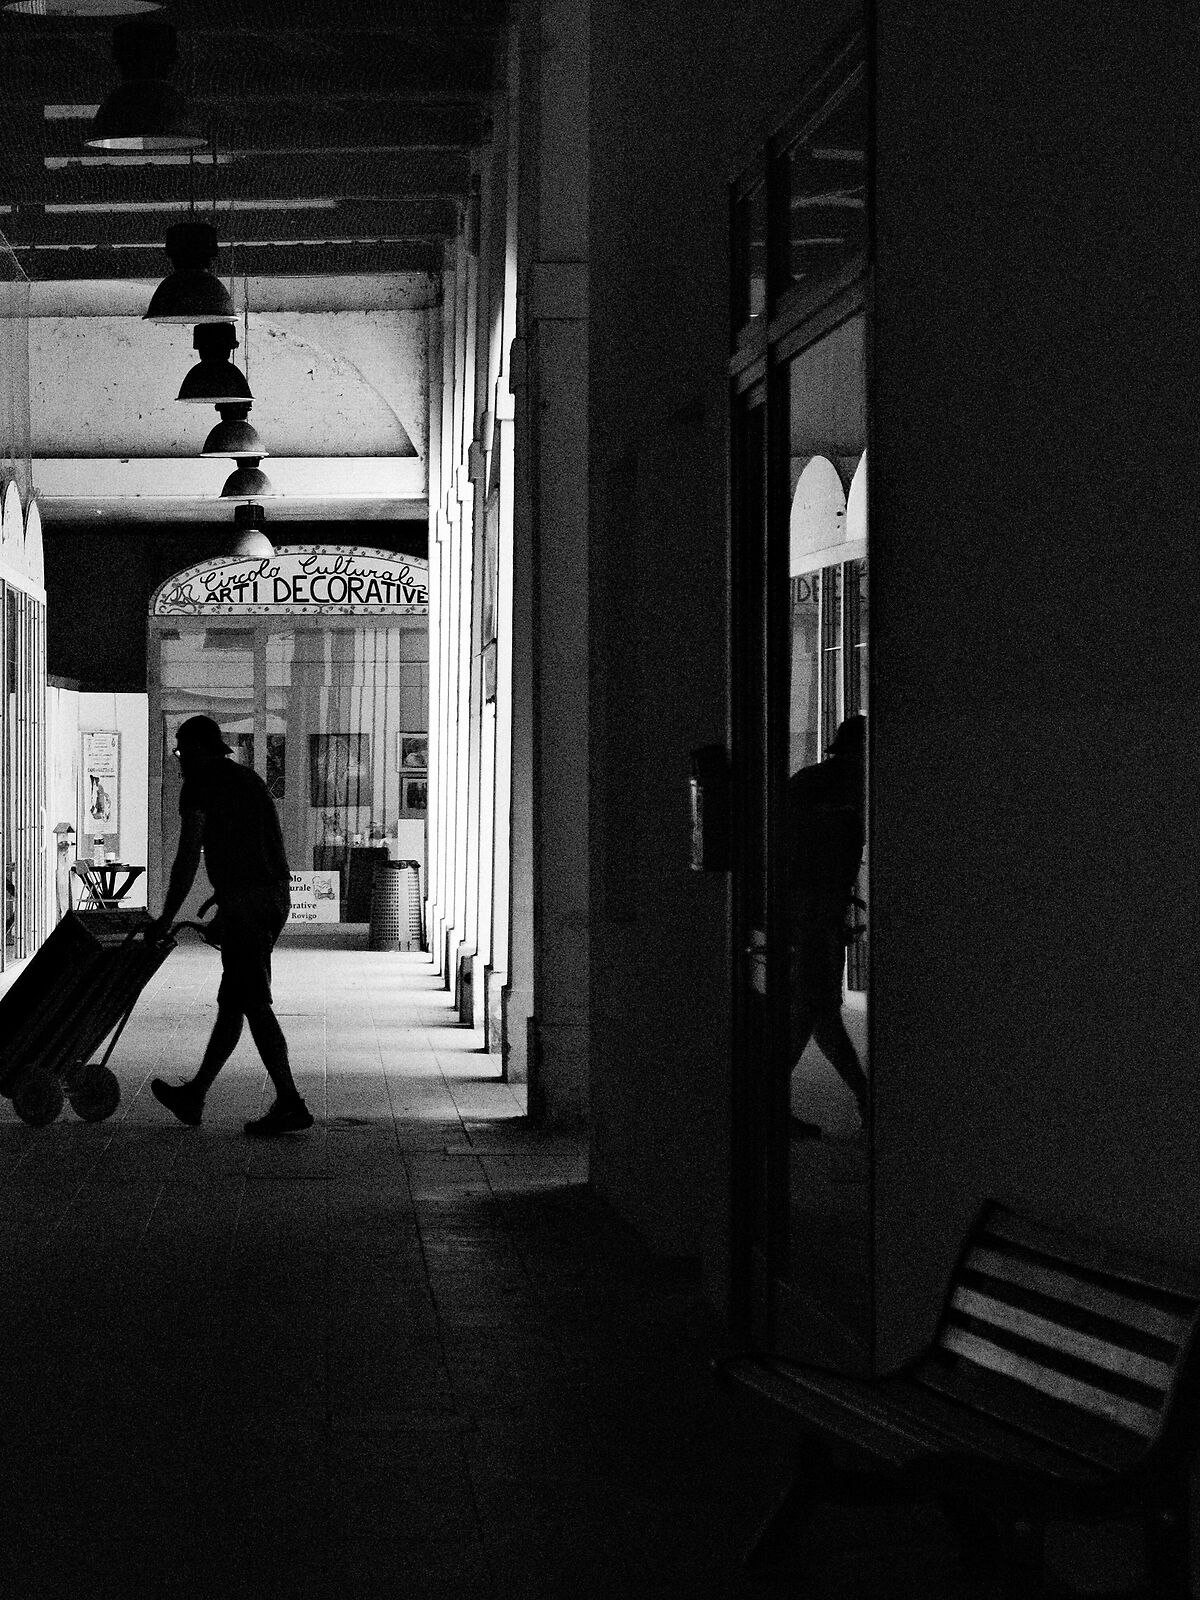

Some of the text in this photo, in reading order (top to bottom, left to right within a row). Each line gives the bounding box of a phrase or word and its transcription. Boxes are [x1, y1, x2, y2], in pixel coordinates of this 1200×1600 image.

[199, 555, 427, 592] Circolo Culturale
[204, 575, 429, 604] ARTI DECORATIVE
[292, 912, 317, 920] Rovigo
